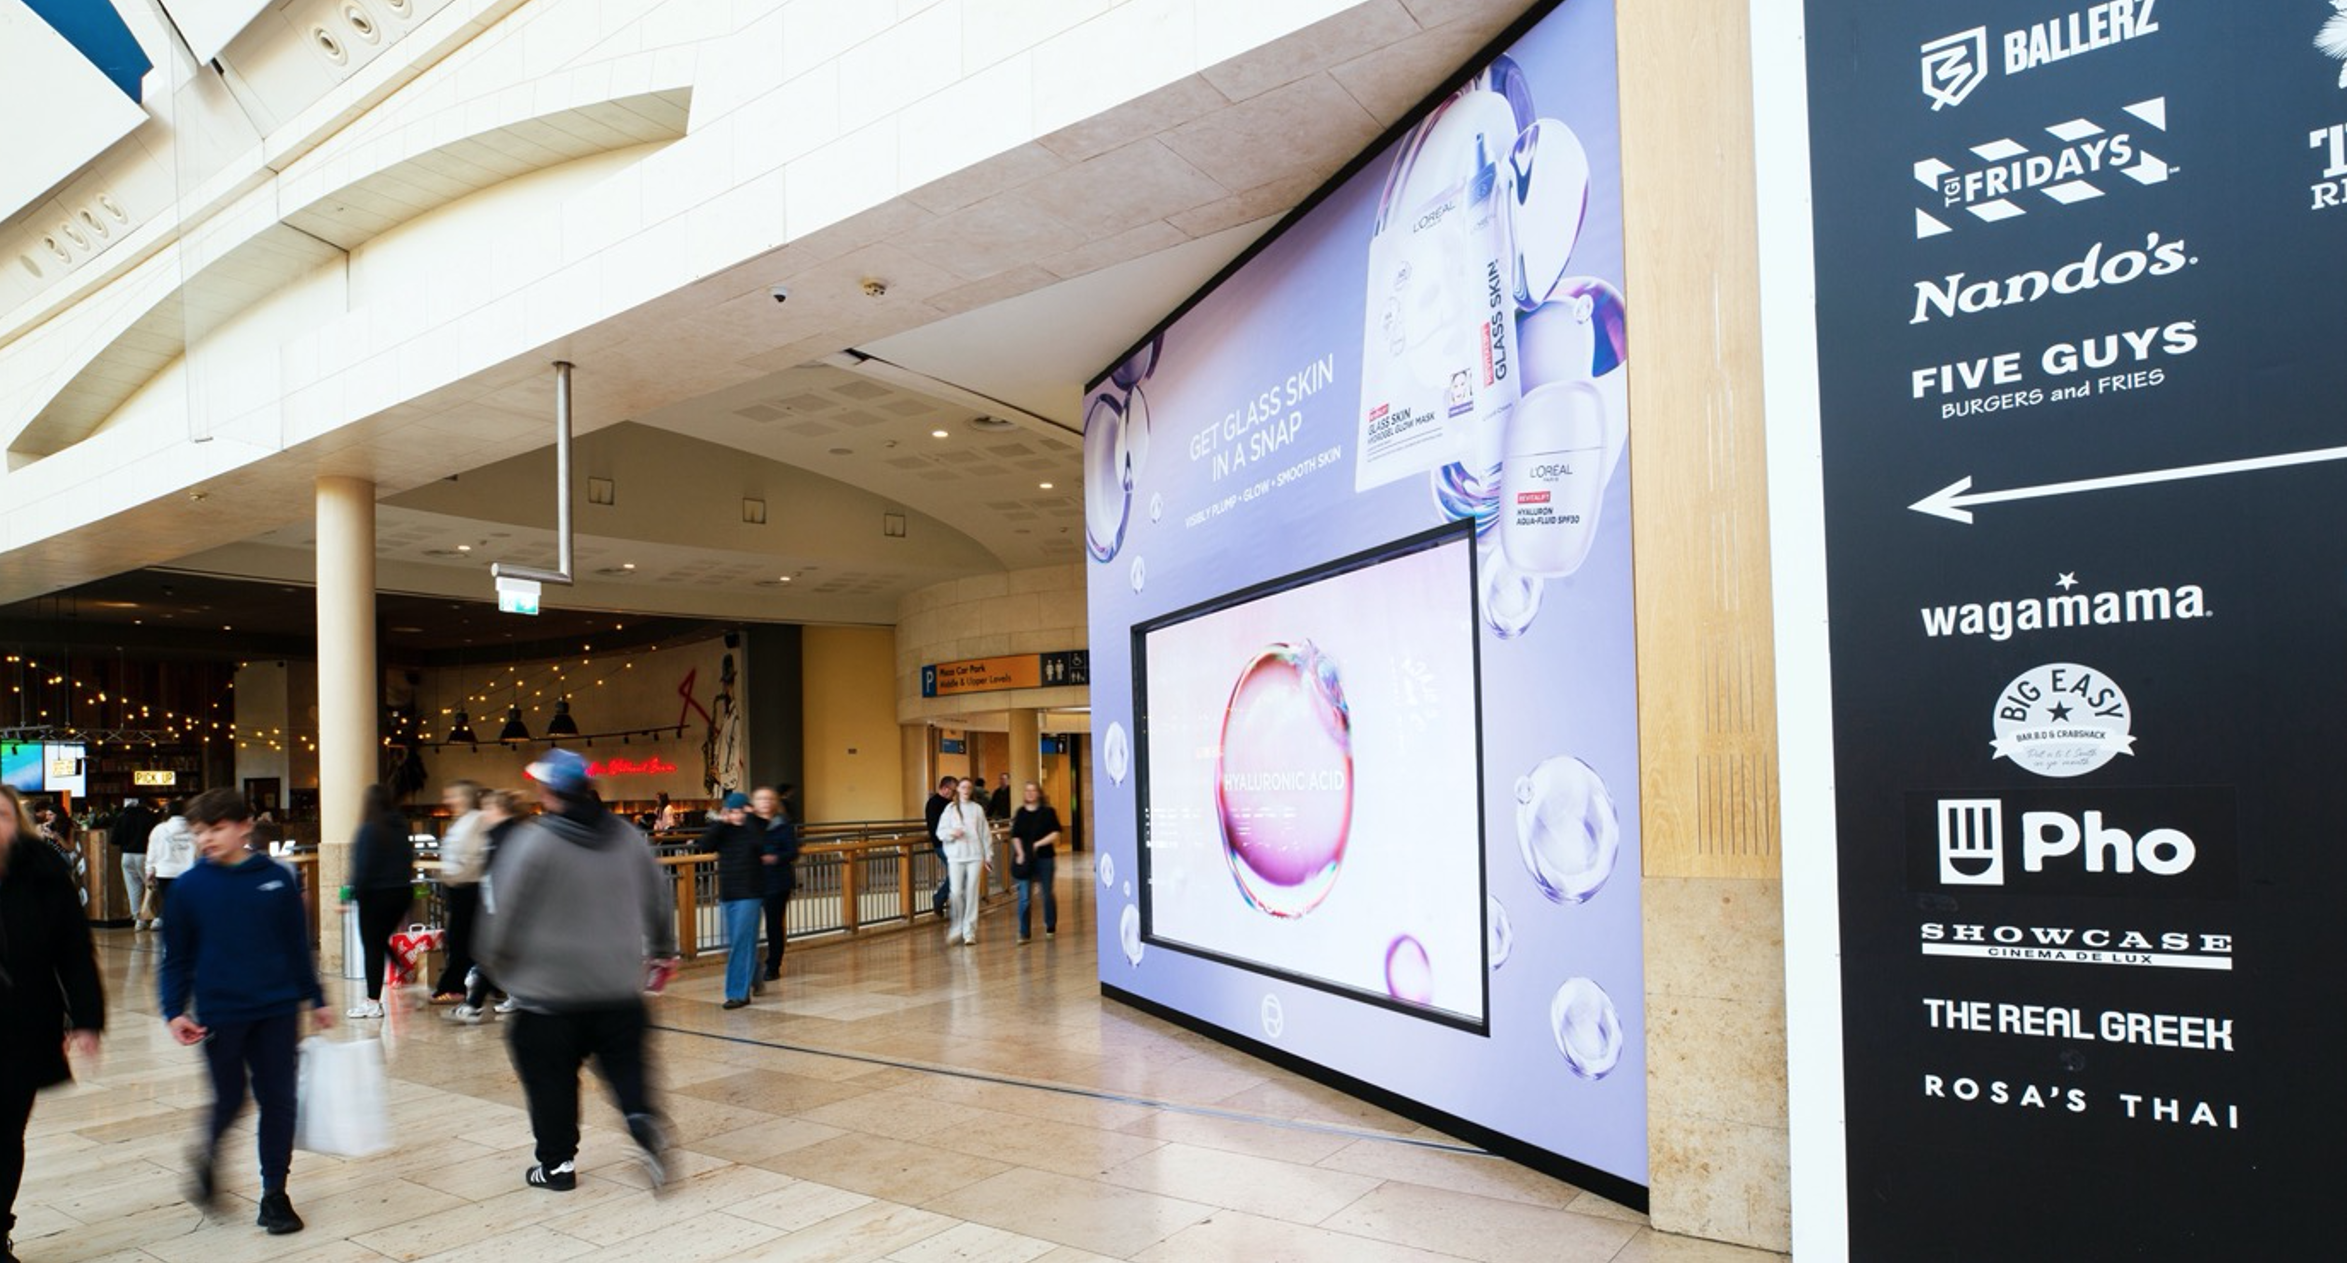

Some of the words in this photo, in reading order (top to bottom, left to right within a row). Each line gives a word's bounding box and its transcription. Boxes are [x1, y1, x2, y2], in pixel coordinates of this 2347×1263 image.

[2004, 0, 2158, 75] BALLERZ
[1944, 177, 1960, 207] TGI
[1965, 134, 2132, 202] FRIDAYS
[1487, 262, 1501, 309] SKIN
[1910, 232, 2192, 324] Nando's
[1492, 311, 1507, 380] GLASS
[1912, 353, 2022, 399] FIVE
[2042, 321, 2197, 375] GUYS
[1189, 422, 1220, 462] GET
[1223, 386, 1280, 441] GLASS
[1286, 353, 1334, 406] SKIN
[1415, 411, 1435, 426] MASK
[1942, 388, 2044, 419] BURGERS
[2051, 380, 2090, 401] and
[2098, 368, 2165, 394] FRIES
[1212, 451, 1229, 482] IN
[1233, 442, 1246, 472] A
[1250, 411, 1302, 462] SNAP
[1368, 415, 1389, 436] GLASS
[1391, 407, 1411, 425] SKIN
[1212, 494, 1237, 517] PLUMP
[1243, 479, 1270, 502] GLOW
[1276, 456, 1316, 487] SMOOTH
[1318, 445, 1342, 469] SKIN
[1517, 507, 1553, 516] HYALURON
[1921, 584, 2204, 641] wagamama
[956, 666, 968, 675] Car
[970, 664, 985, 673] Park
[2000, 680, 2041, 722] BIG
[2051, 669, 2124, 718] EASY
[2057, 729, 2106, 740] CRABSHACK
[136, 772, 157, 784] PICK
[163, 772, 174, 784] UP
[1225, 771, 1305, 791] HYALURONIC
[1309, 770, 1345, 791] ACID
[2023, 811, 2195, 875] Pho
[1921, 923, 2232, 953] SHOWCASE
[1988, 948, 2066, 960] CINEMA
[2076, 952, 2102, 961] DE
[2113, 954, 2152, 964] LUX
[1924, 999, 1991, 1032] THE
[1999, 1004, 2094, 1040] REAL
[2101, 1012, 2233, 1051] GREEK
[1926, 1075, 2086, 1112] ROSA'S
[2120, 1095, 2238, 1129] THAI
